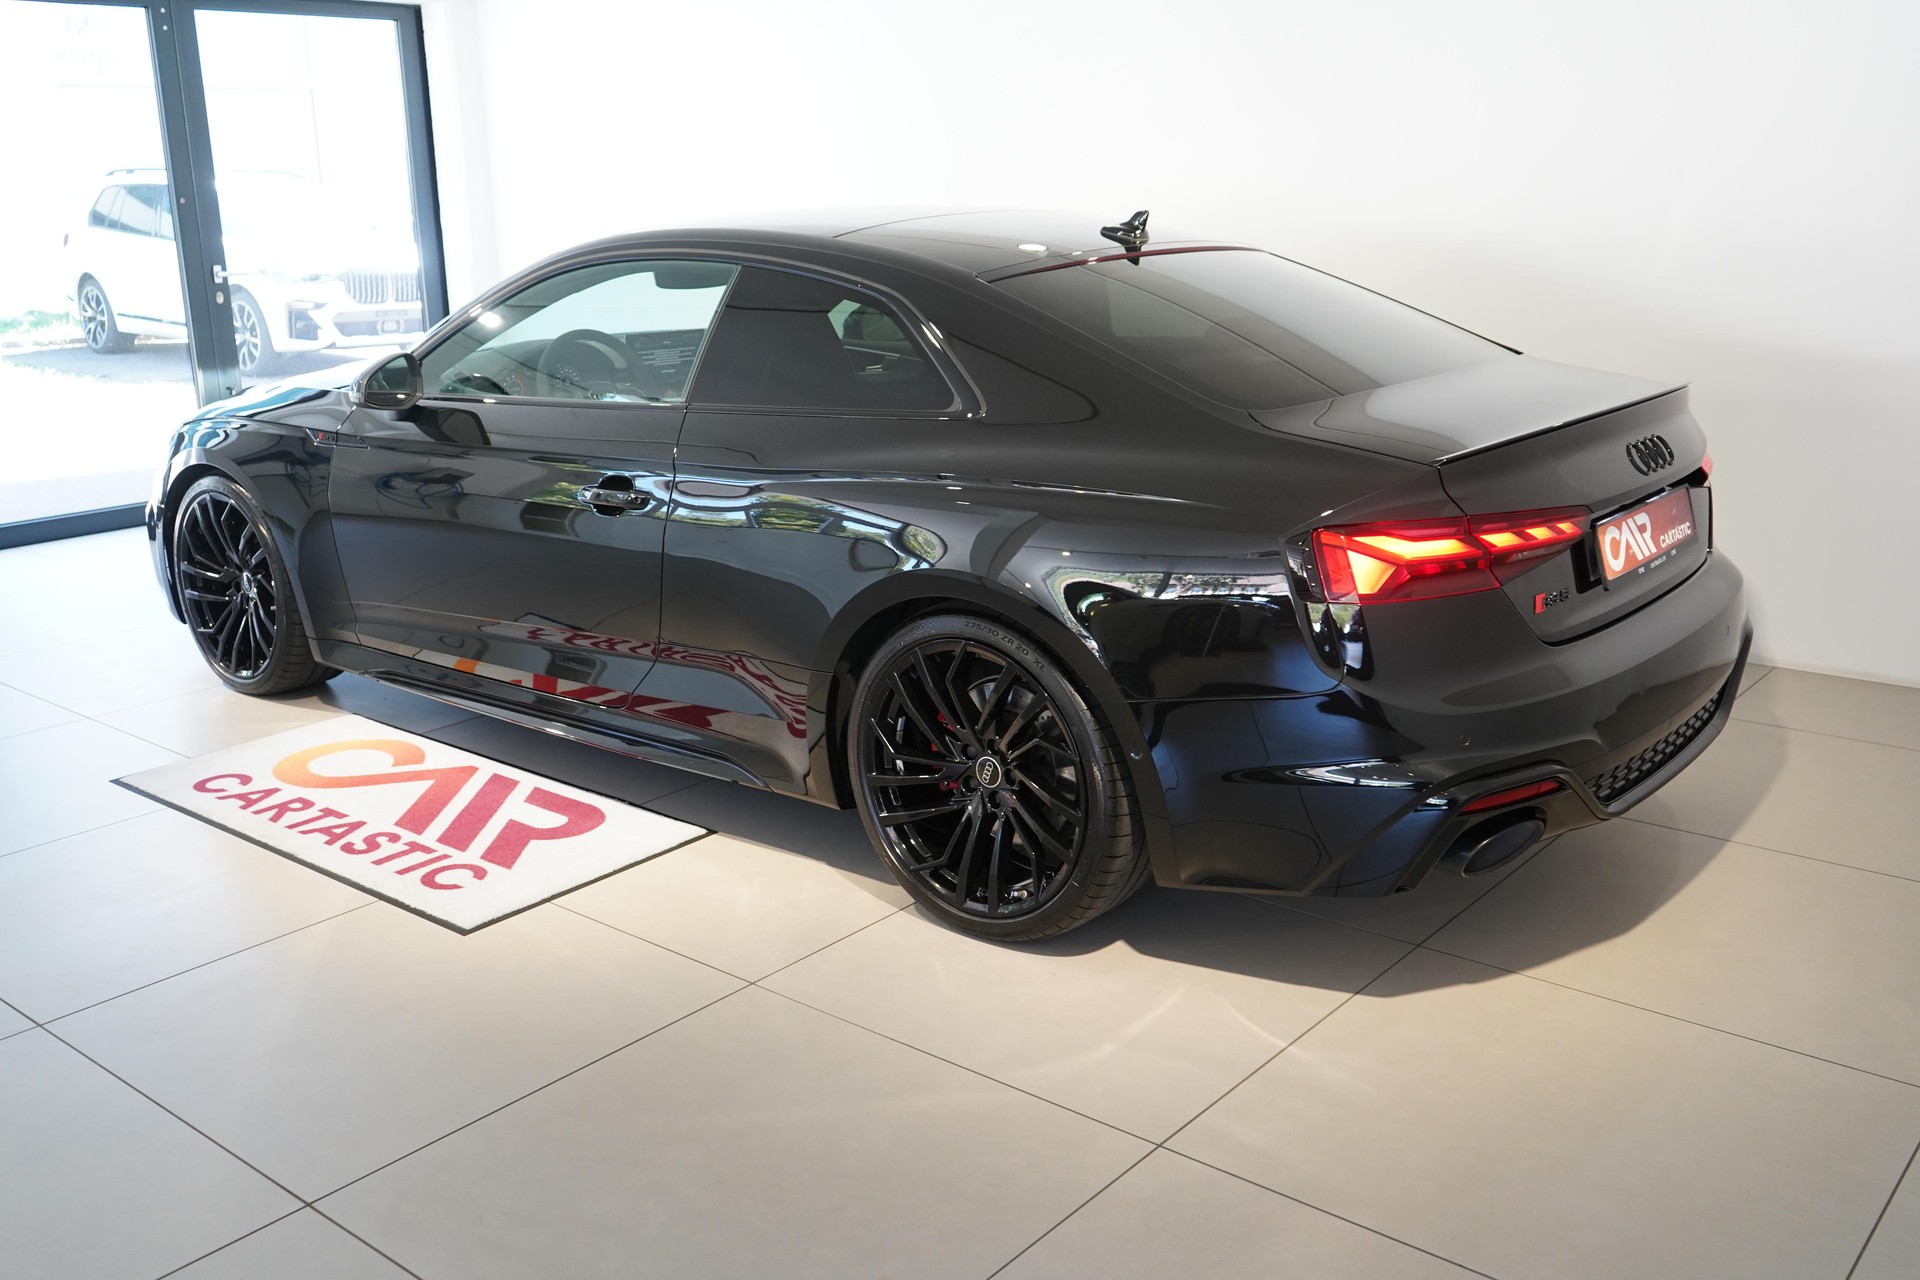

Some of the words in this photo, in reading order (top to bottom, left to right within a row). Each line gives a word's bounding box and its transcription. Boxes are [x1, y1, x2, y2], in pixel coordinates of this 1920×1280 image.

[1660, 522, 1692, 548] CARTASTIC
[963, 621, 999, 636] 275/30
[1000, 633, 1015, 646] ZR
[1015, 643, 1029, 657] 20
[1033, 657, 1045, 672] XL
[192, 773, 489, 890] CARTASTIC
[272, 738, 606, 870] CAR
